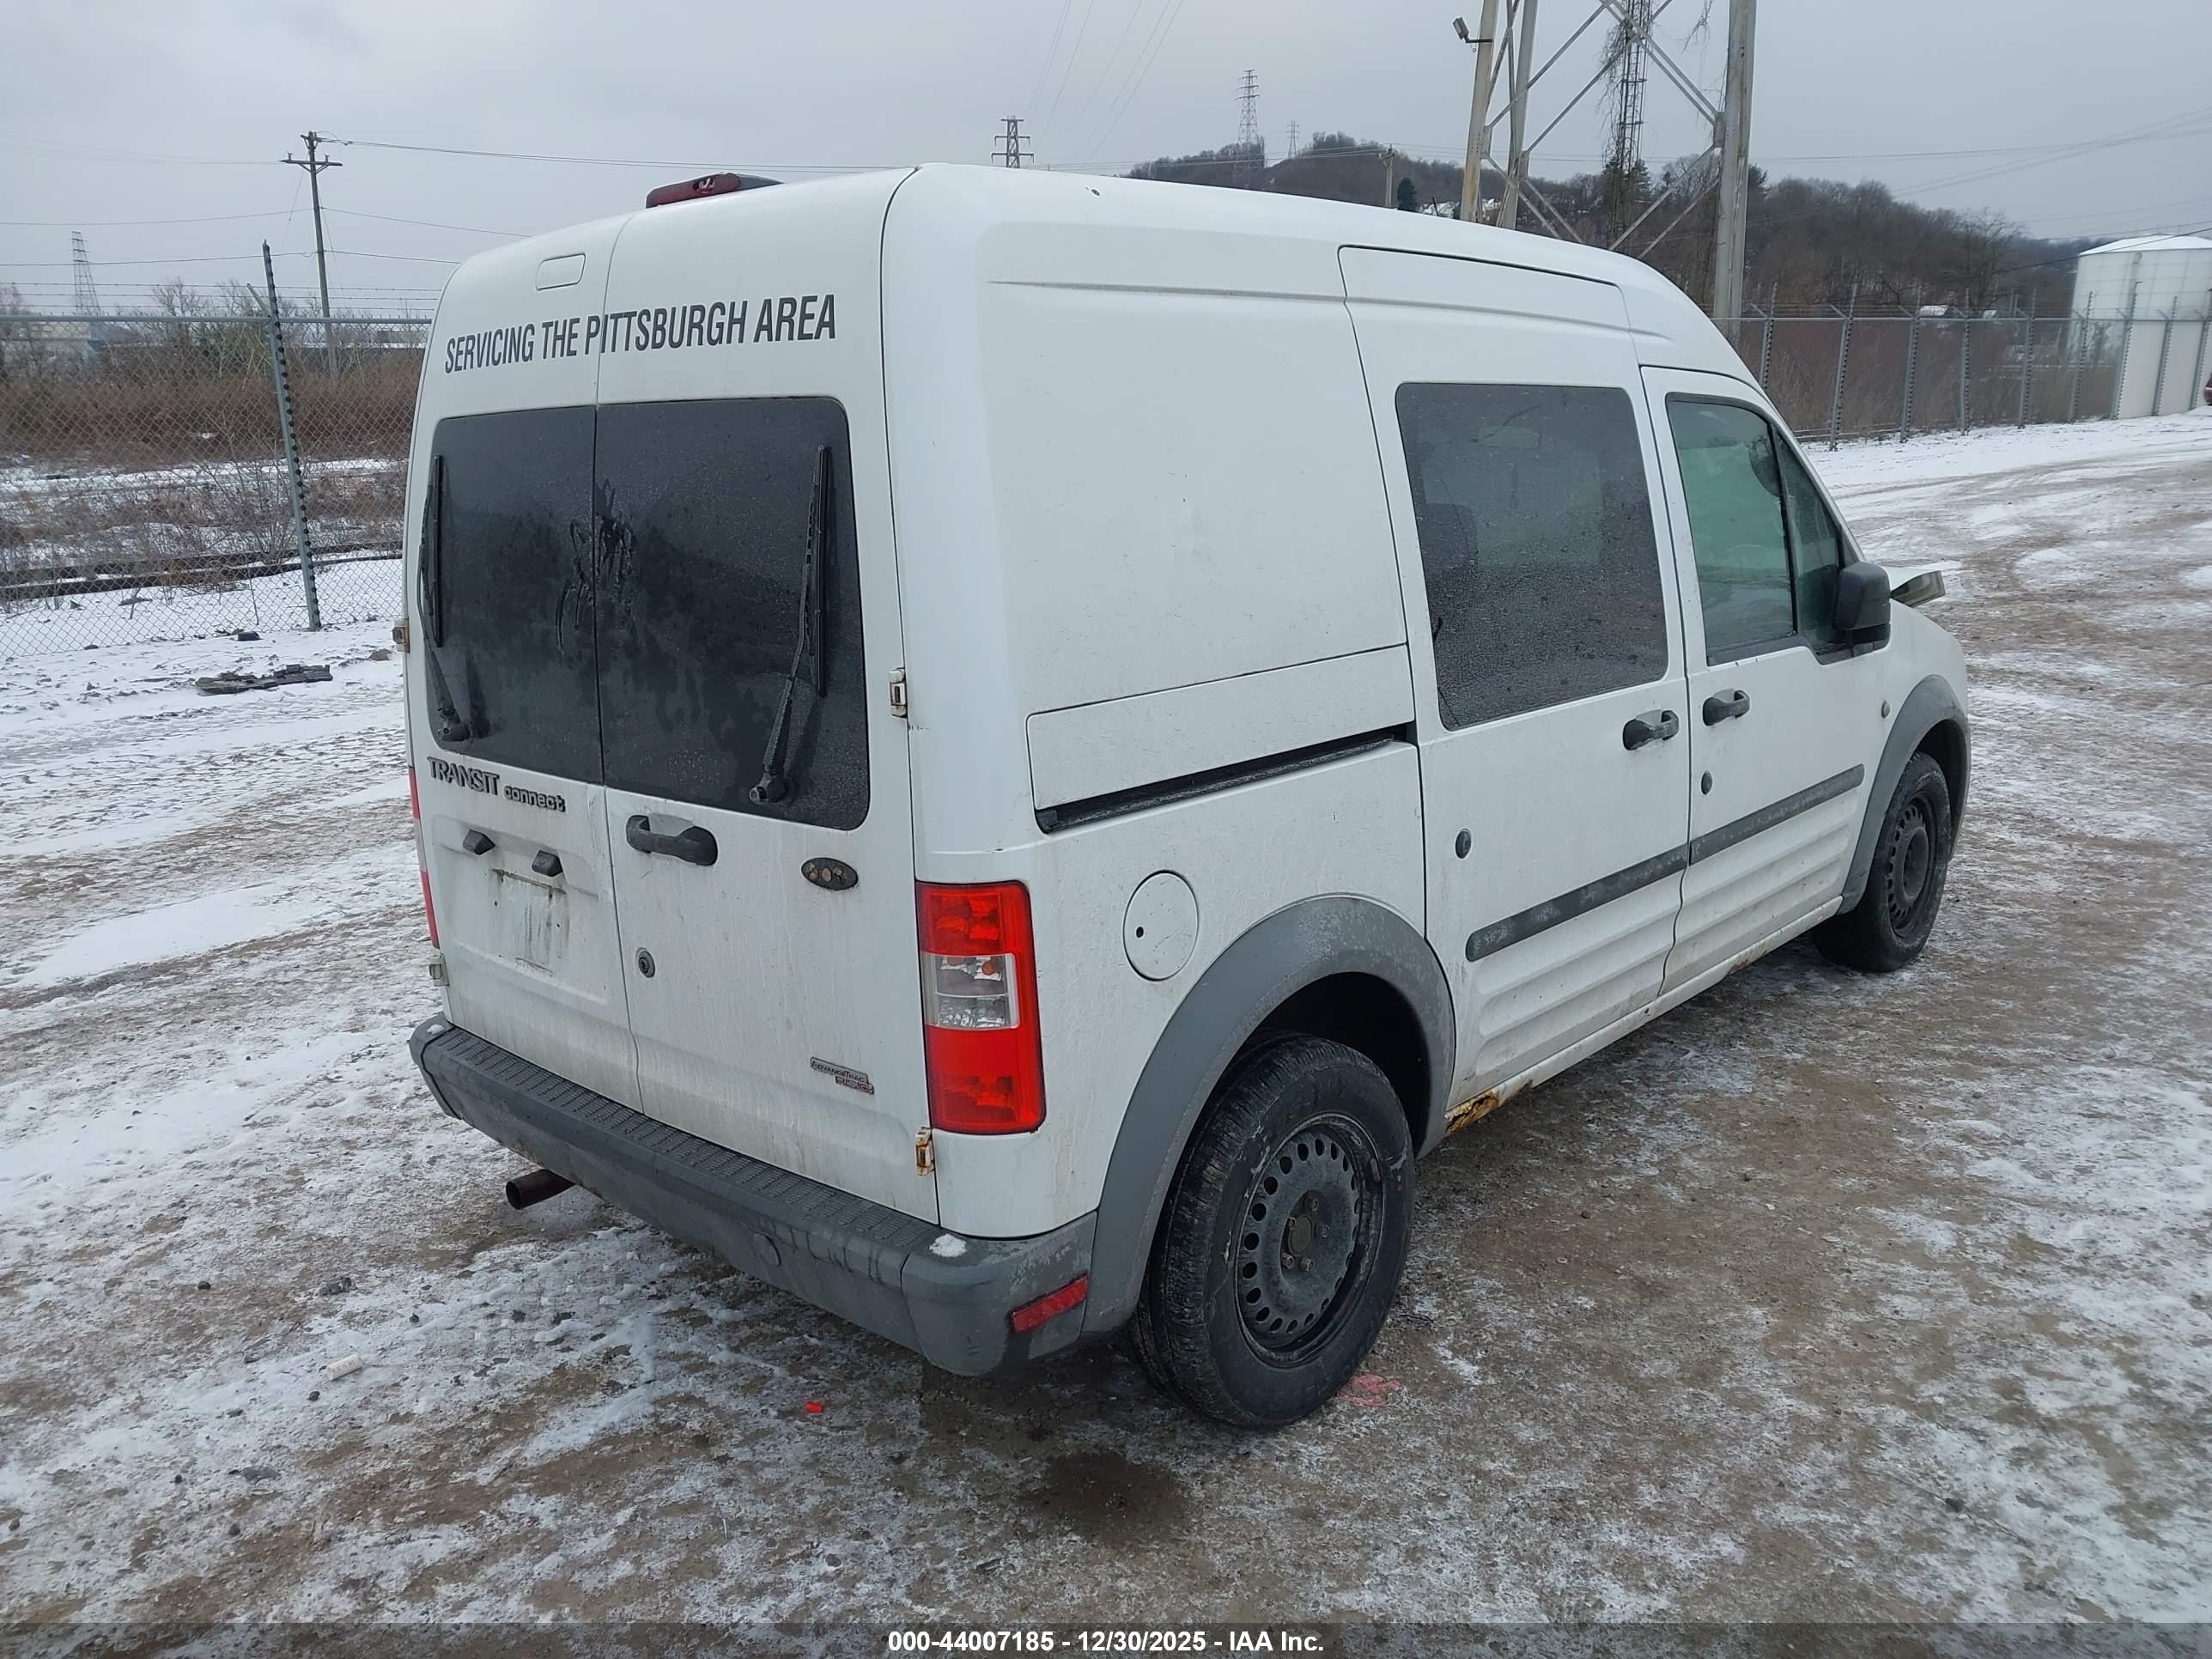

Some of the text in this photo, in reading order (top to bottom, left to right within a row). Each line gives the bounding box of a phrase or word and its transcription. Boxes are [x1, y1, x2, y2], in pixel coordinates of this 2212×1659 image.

[445, 294, 836, 374] SERVICING THE PITTSBURGH AREA
[427, 756, 567, 813] TRANSIT connect
